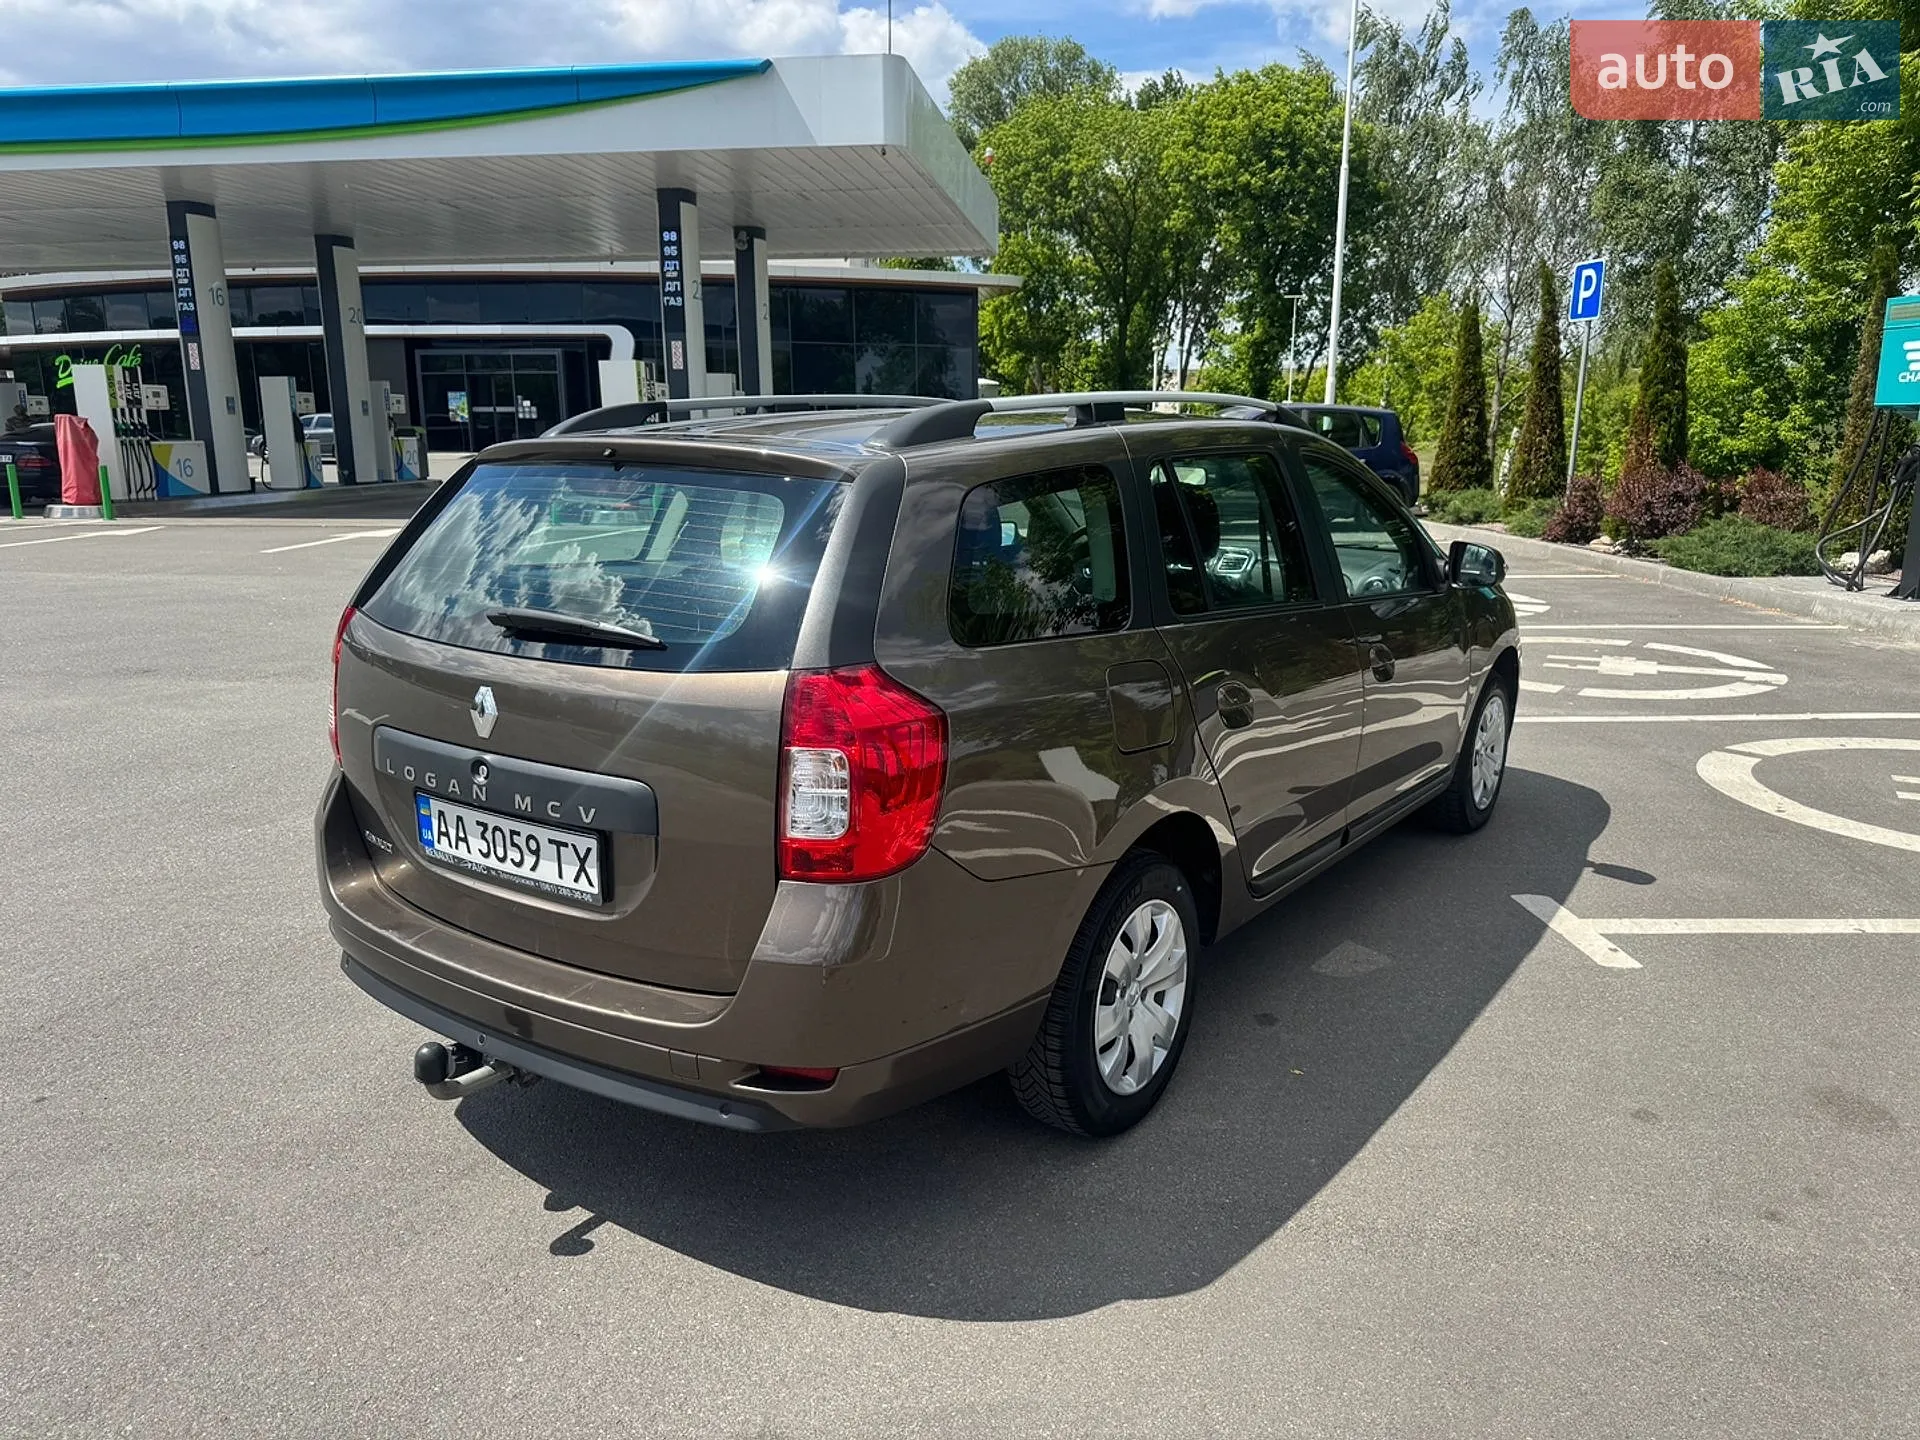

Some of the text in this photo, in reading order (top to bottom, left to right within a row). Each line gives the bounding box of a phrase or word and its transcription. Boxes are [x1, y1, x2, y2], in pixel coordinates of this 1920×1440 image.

[663, 231, 677, 242] 98
[173, 240, 186, 250] 98
[208, 285, 225, 307] 16
[1577, 268, 1597, 315] P
[178, 302, 195, 312] ГАЗ
[664, 295, 683, 307] ГАЗ
[176, 458, 194, 478] 16
[386, 758, 596, 824] LOGAN MCV
[422, 828, 434, 841] UA
[437, 809, 472, 855] AA
[475, 819, 541, 873] 3059
[547, 837, 596, 888] TX
